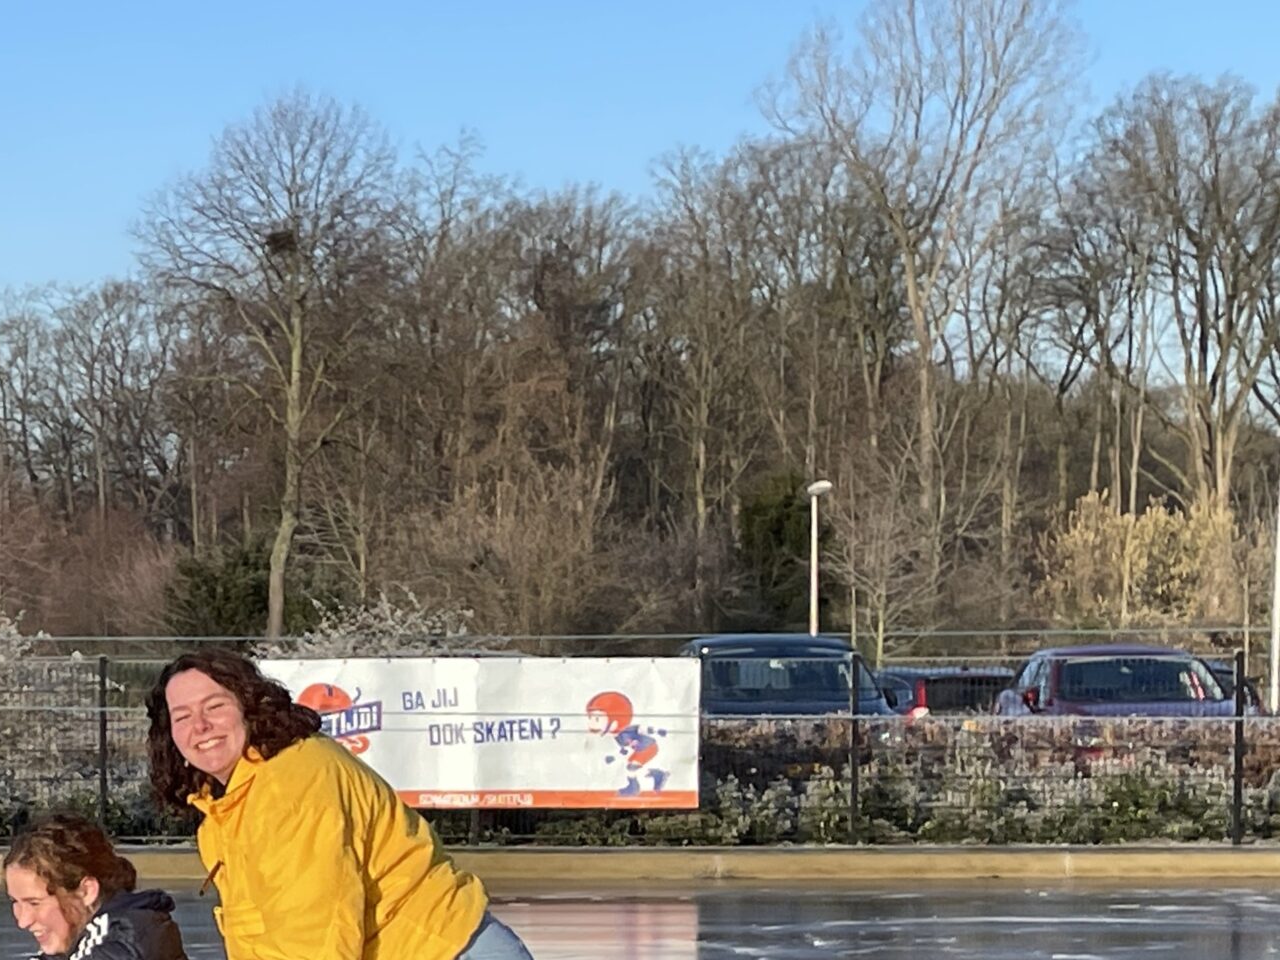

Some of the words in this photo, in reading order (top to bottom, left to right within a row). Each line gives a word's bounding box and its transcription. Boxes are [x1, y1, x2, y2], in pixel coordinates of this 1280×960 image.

[402, 690, 425, 711] GA
[431, 687, 459, 709] JIJ
[429, 722, 466, 746] OOK
[473, 718, 543, 744] SKATEN
[550, 717, 561, 740] ?
